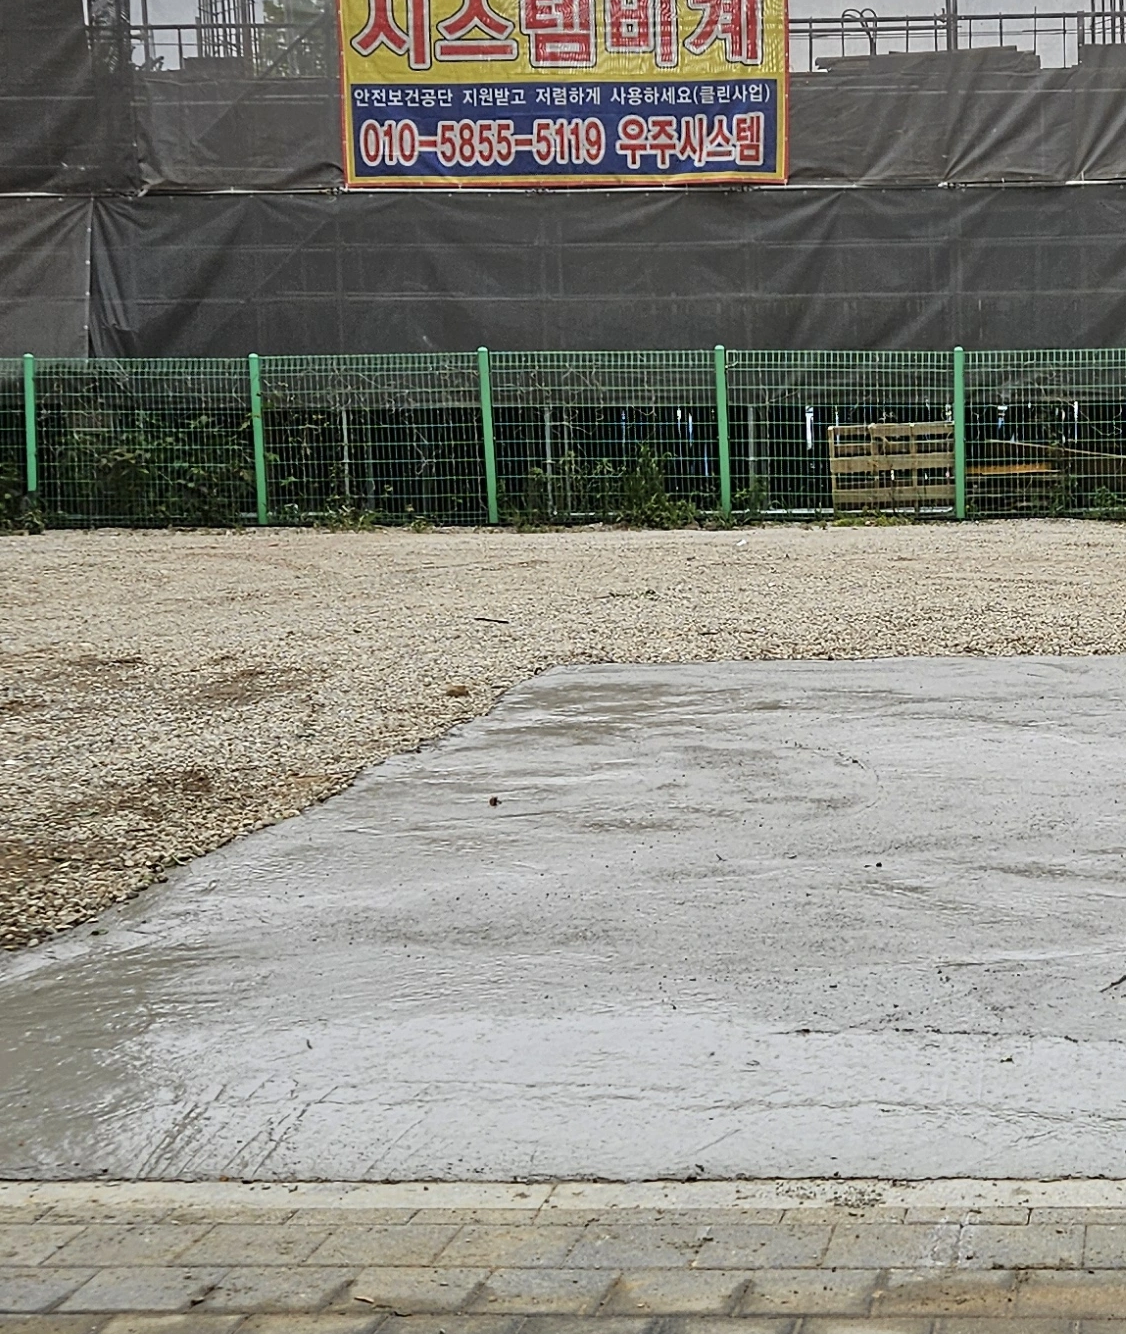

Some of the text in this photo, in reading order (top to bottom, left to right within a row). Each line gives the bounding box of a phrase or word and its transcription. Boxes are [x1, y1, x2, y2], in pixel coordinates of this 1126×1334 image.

[354, 83, 770, 108] 안전보건공단 지원받고 저렴하게 사용하세요(클린사업)
[359, 111, 765, 169] 010-5855-5119 우주시스템
